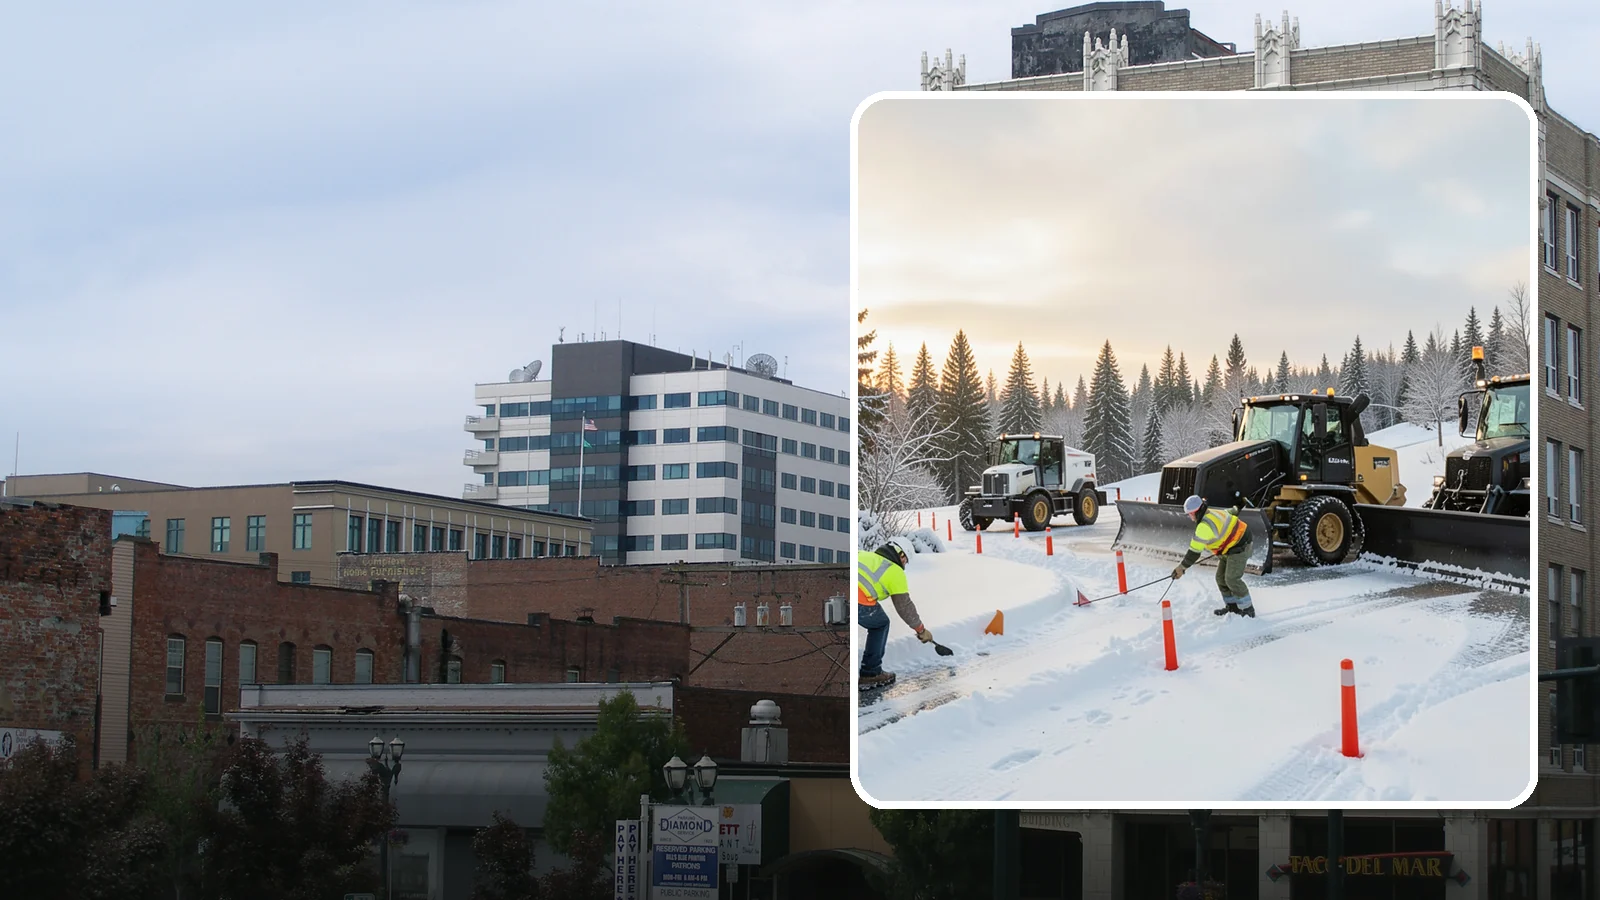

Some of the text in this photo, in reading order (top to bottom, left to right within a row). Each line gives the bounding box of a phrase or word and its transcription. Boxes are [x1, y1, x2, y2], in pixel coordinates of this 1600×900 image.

[370, 566, 428, 577] Furnishers
[660, 818, 713, 832] DIAMOND
[1022, 815, 1070, 828] BUILDING
[656, 845, 716, 854] RESERVED PARKING
[616, 824, 625, 894] PAY HERE
[627, 824, 637, 893] PAY HERE
[721, 851, 739, 862] Soup
[671, 862, 701, 870] PATRONS
[1345, 857, 1385, 876] DEL
[1392, 857, 1443, 877] MAR
[660, 889, 710, 898] PUBLIC PARKING
